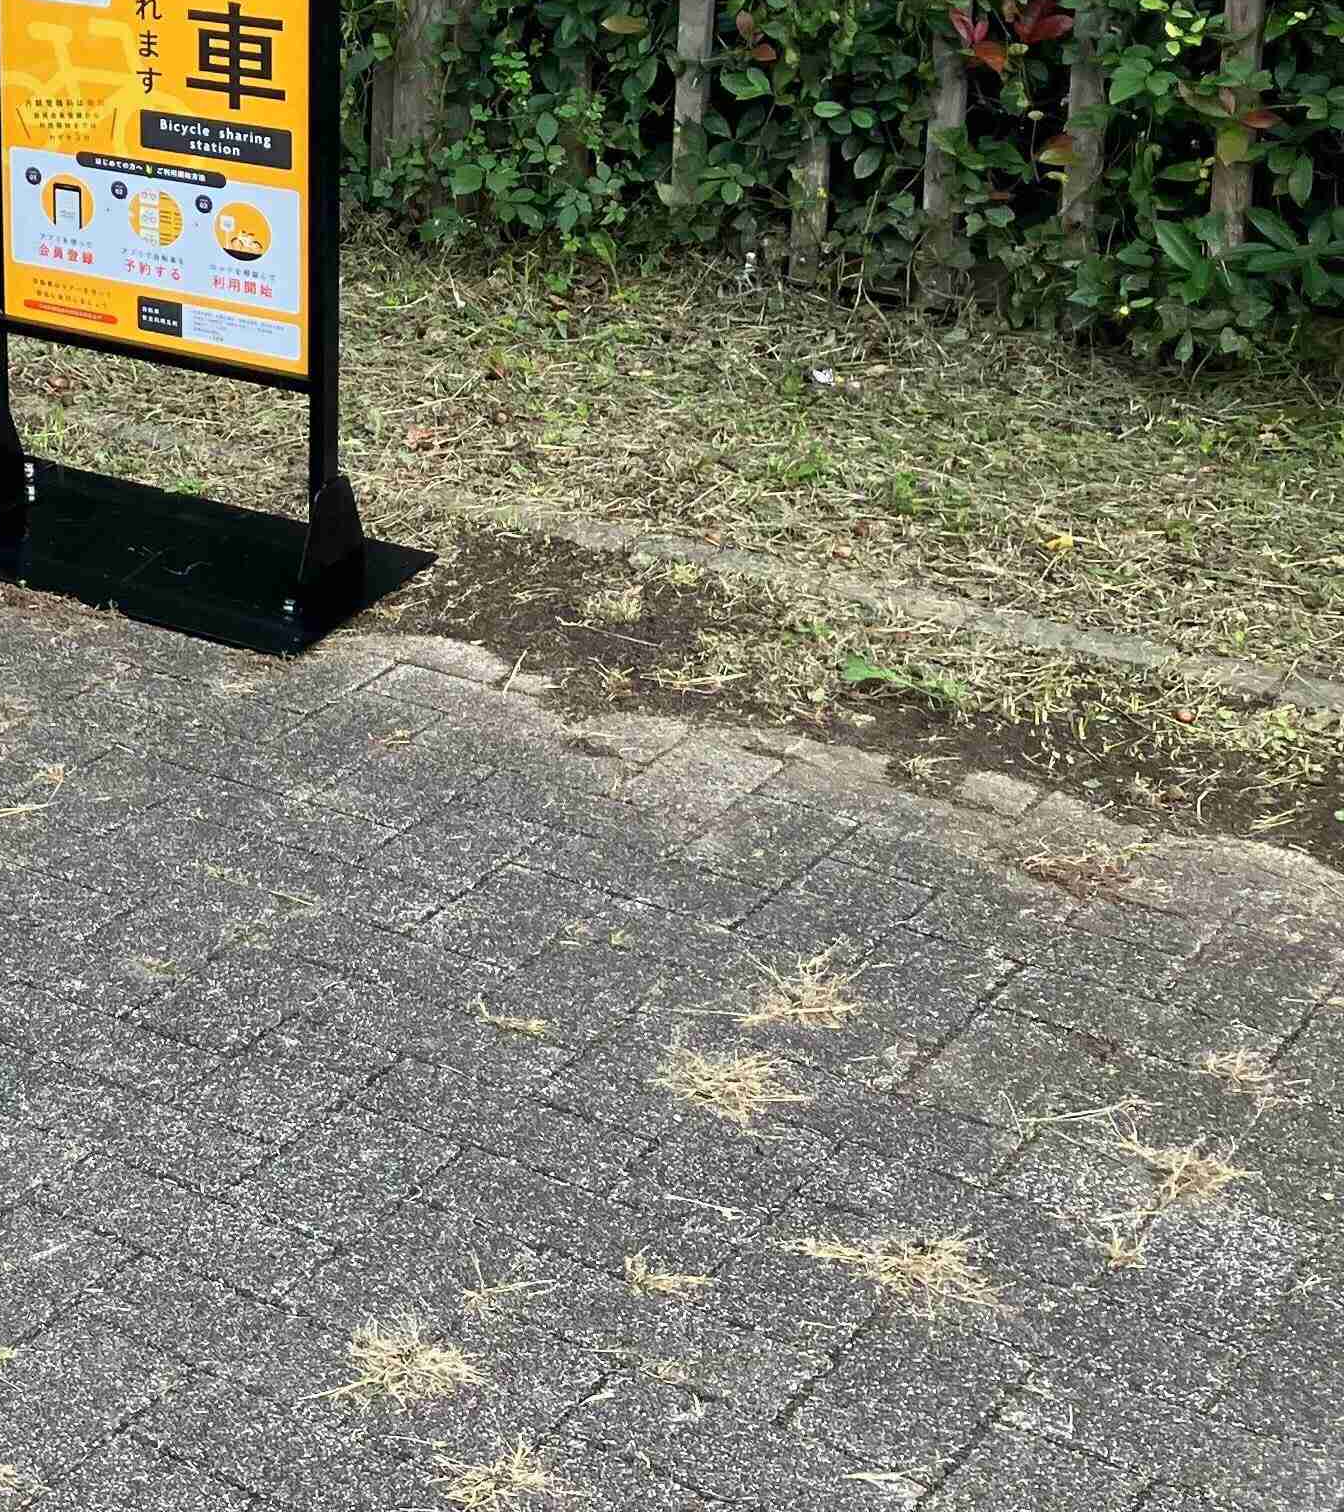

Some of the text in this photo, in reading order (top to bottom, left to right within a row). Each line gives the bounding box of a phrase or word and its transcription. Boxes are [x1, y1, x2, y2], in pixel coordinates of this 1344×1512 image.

[159, 118, 272, 149] Bicycle sharing
[189, 138, 241, 157] station
[39, 243, 96, 265] 会員登録
[123, 258, 183, 281] 予約する
[212, 275, 274, 299] 利用開始
